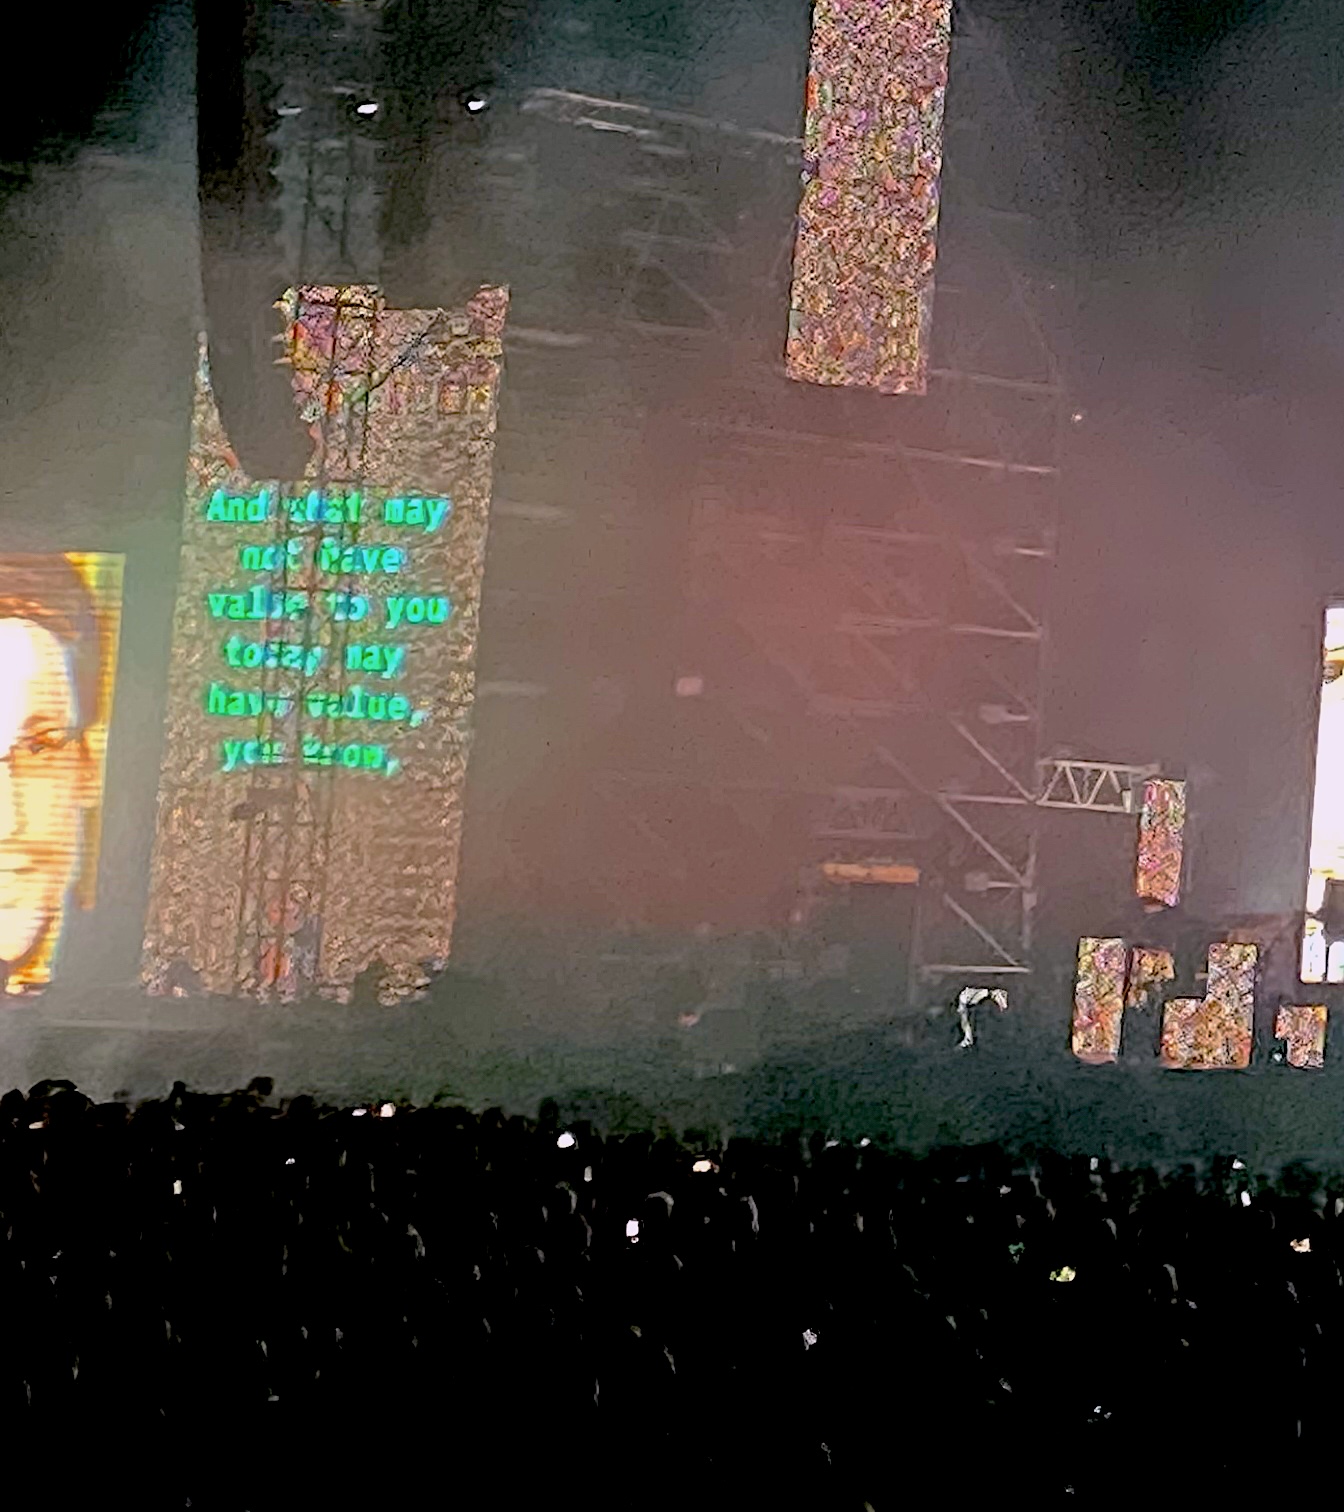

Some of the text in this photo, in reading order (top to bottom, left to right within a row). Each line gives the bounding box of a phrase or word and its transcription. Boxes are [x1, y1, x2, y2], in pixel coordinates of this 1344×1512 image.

[206, 489, 270, 522] And
[385, 496, 447, 532] may
[386, 596, 447, 630] you
[346, 643, 405, 679] may
